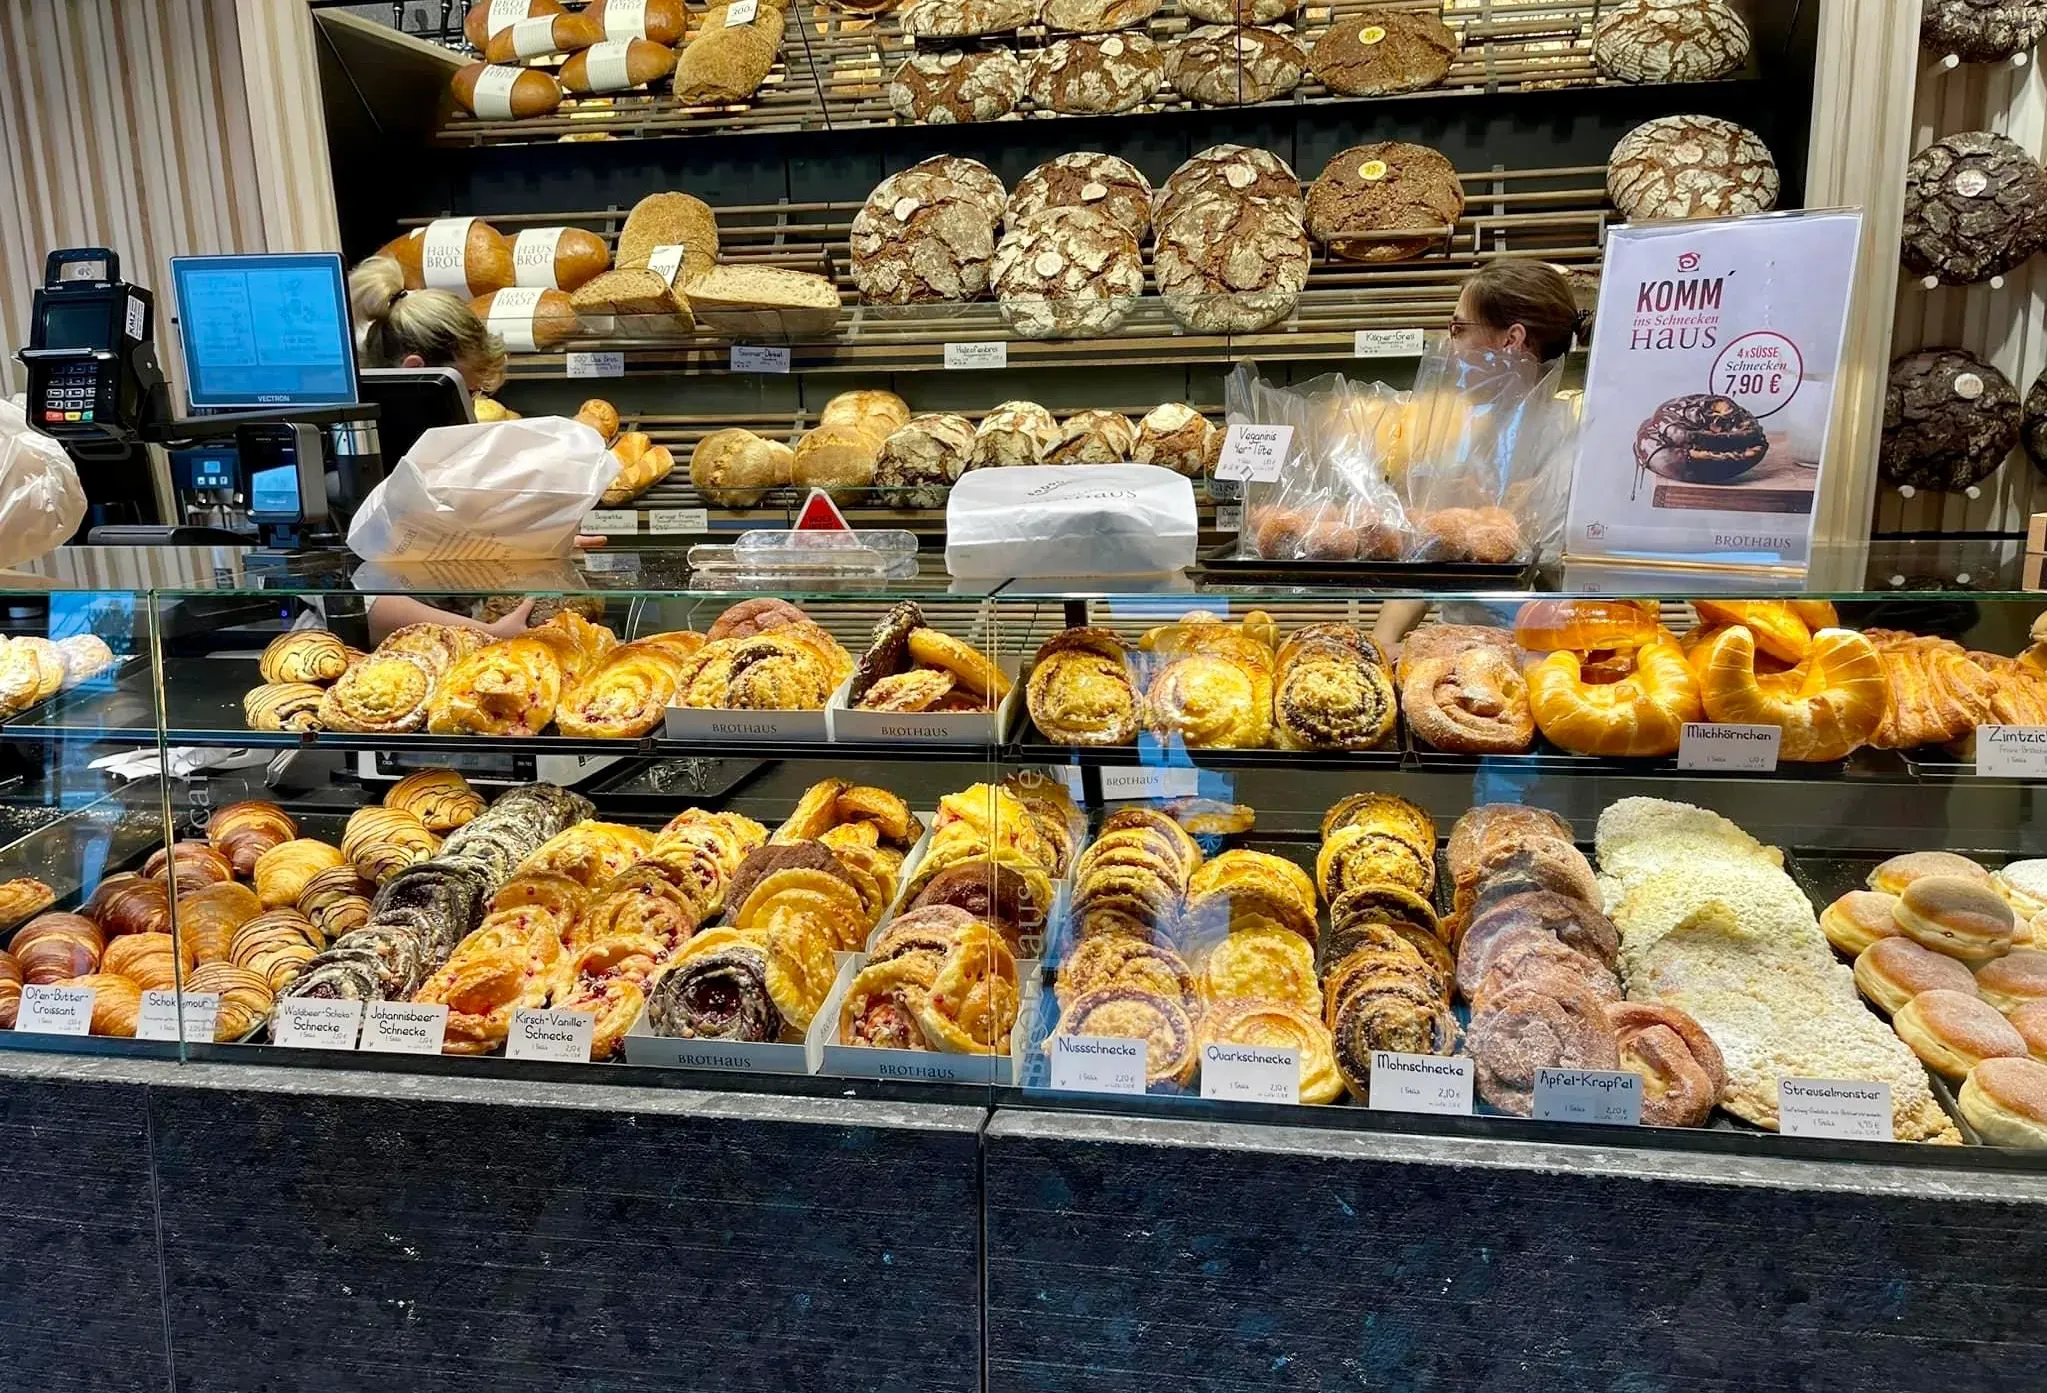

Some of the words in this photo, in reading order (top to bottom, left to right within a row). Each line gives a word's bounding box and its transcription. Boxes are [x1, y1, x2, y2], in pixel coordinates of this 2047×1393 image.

[1633, 315, 1651, 327] ins
[1654, 313, 1719, 327] Schnecken
[1749, 346, 1779, 359] SÜSSE
[1724, 359, 1787, 372] Schnecken
[1723, 373, 1763, 396] 7,90
[1769, 373, 1782, 394] €
[257, 395, 290, 403] VECTRON
[1687, 724, 1772, 741] Milchhörnchen
[1987, 725, 2047, 743] Zimtzic
[33, 1000, 76, 1016] Croissant
[370, 1005, 440, 1023] Johannisbeer-
[293, 1016, 341, 1033] Schnecke
[379, 1019, 426, 1037] Schnecke
[515, 1010, 588, 1028] Kirsch-Vanille-
[525, 1024, 574, 1042] Schnecke
[1058, 1036, 1137, 1056] Nussschnecke
[1207, 1045, 1292, 1065] Quarkschnecke
[1377, 1053, 1464, 1076] Mohnschnecke
[1540, 1070, 1633, 1092] Apfel-Krapfel
[1783, 1080, 1881, 1100] Streuselmonster
